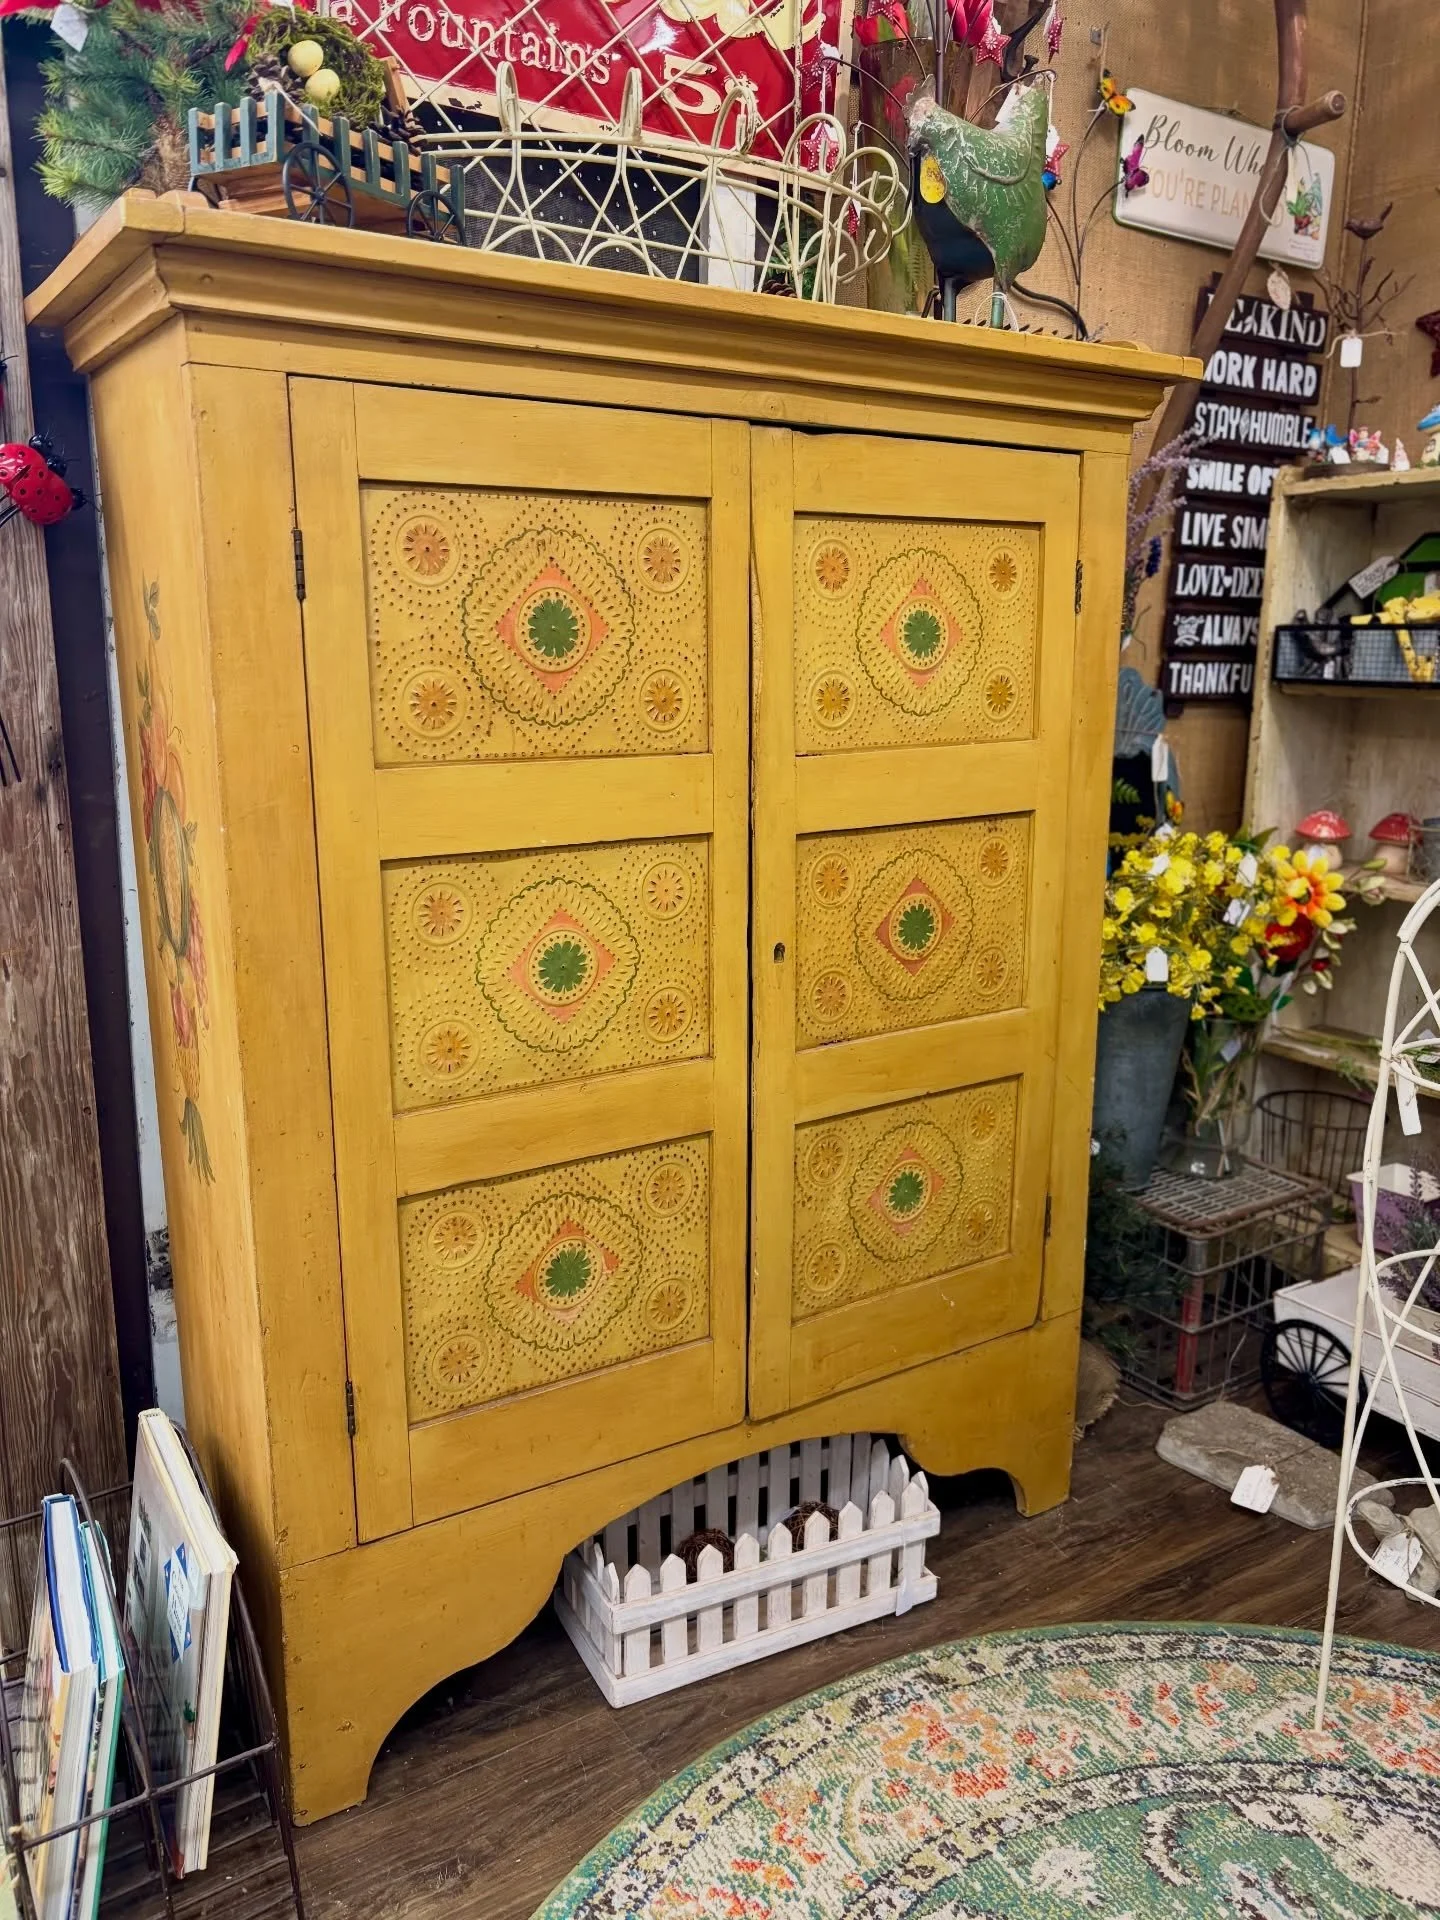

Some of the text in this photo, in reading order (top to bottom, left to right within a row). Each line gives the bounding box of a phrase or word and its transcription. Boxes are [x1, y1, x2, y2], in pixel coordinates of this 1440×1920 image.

[1144, 114, 1220, 162] Bloom
[1149, 166, 1207, 209] OU'RE
[1258, 303, 1327, 347] KIND
[1261, 357, 1318, 397] HARD
[1194, 402, 1313, 449] STAY HUMBLE
[1186, 459, 1245, 493] SMILE
[1180, 511, 1227, 547] LIVE
[1175, 564, 1224, 596] LOVE
